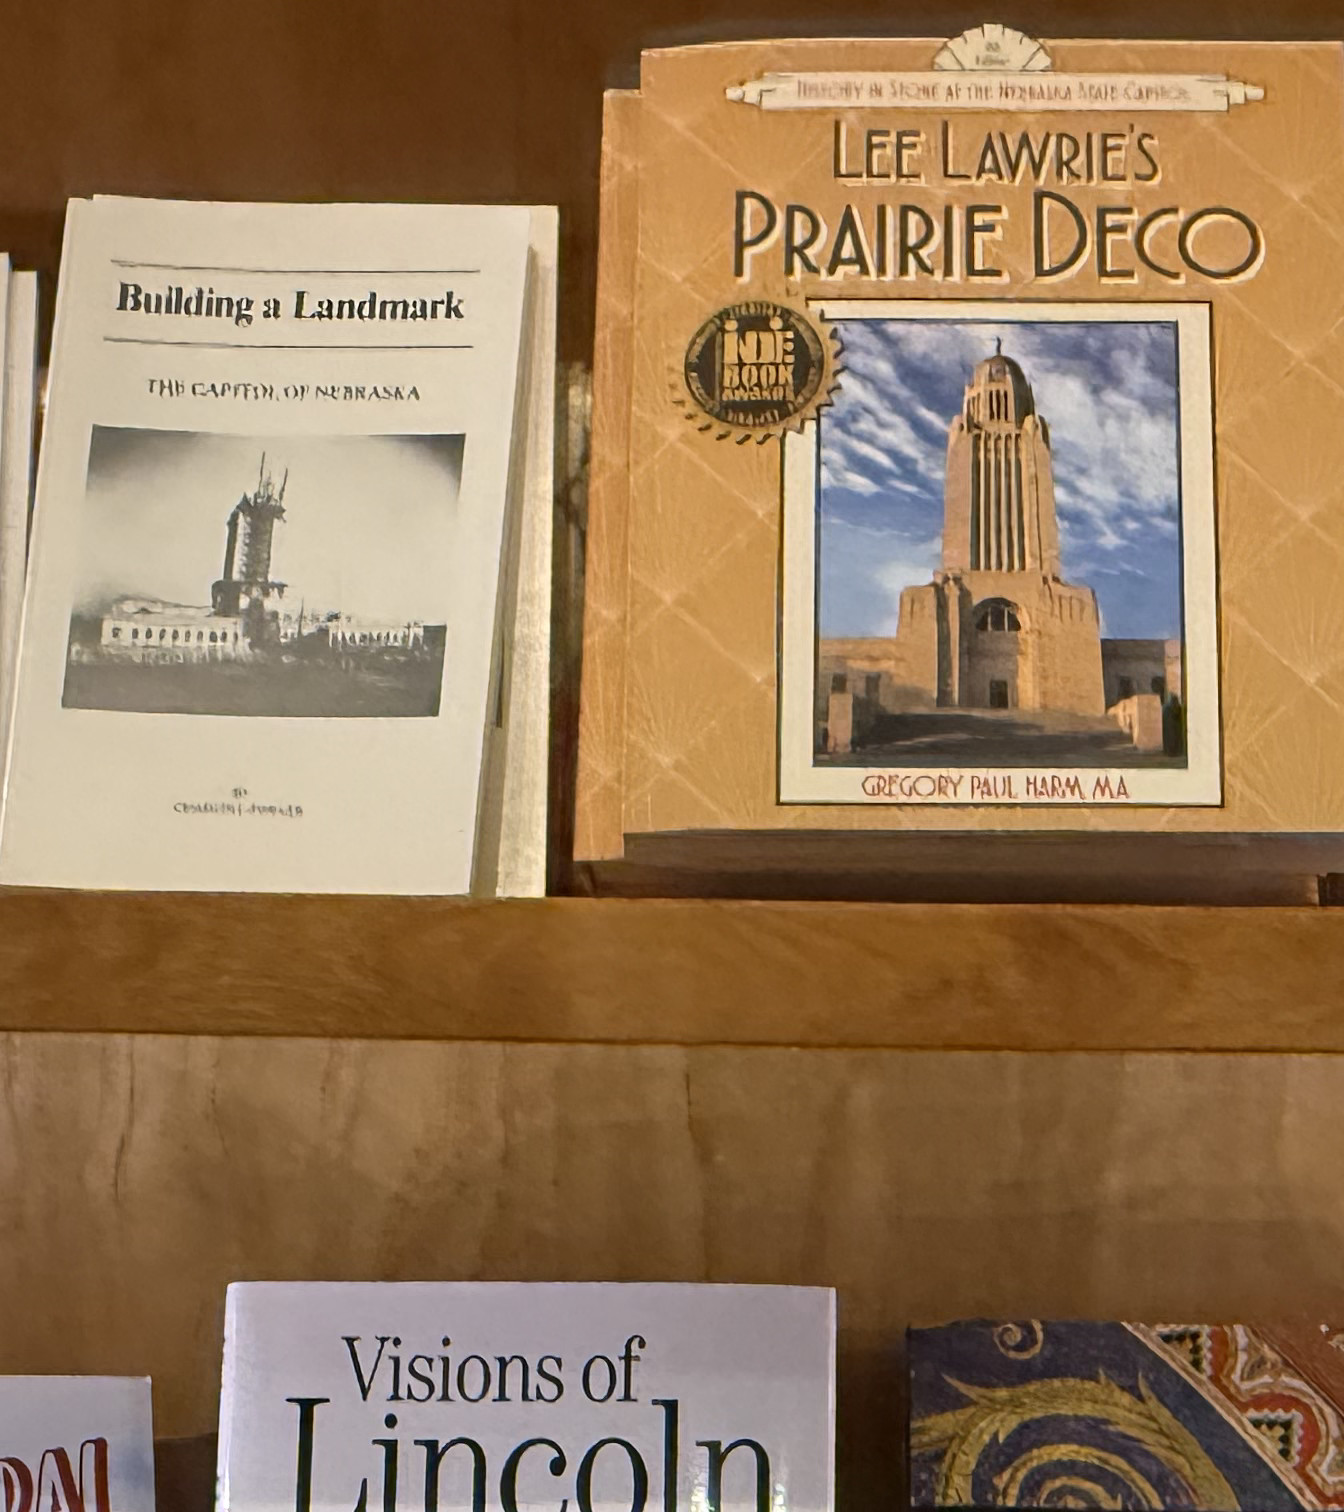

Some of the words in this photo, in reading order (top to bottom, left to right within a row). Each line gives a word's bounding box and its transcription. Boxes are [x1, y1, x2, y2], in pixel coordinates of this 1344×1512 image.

[833, 119, 924, 182] LEE
[942, 119, 1160, 184] LAWRIE'S
[734, 189, 1009, 282] PRAIRIE
[1034, 189, 1264, 283] DECO
[116, 281, 254, 327] Building
[262, 298, 281, 319] a
[294, 289, 465, 321] Landmark
[861, 774, 964, 799] GREGORY
[971, 775, 1017, 800] PAUL
[342, 1335, 564, 1403] Visions
[582, 1333, 647, 1403] of
